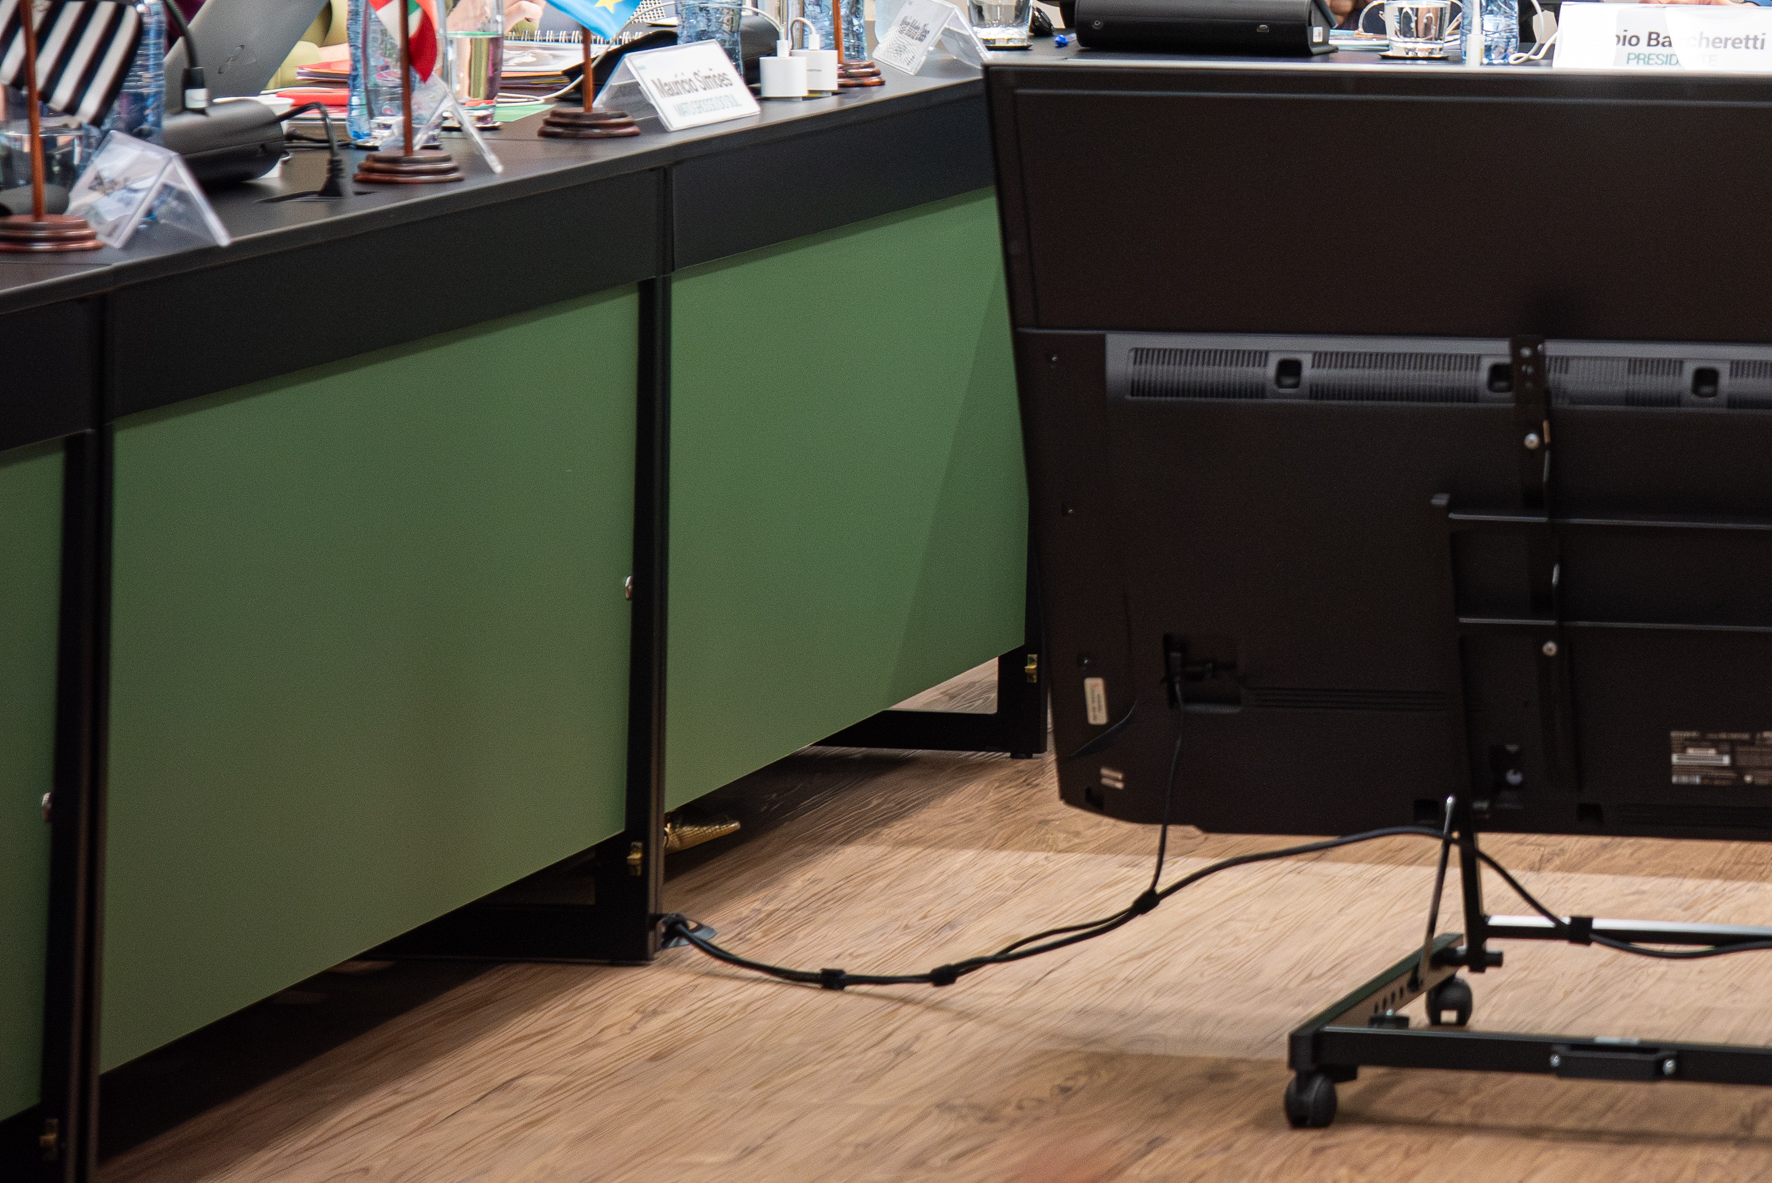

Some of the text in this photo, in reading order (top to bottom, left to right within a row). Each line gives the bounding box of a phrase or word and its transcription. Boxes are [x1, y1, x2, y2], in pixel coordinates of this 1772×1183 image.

[1646, 30, 1767, 50] Bacheretti
[650, 68, 734, 99] Maurício Simões
